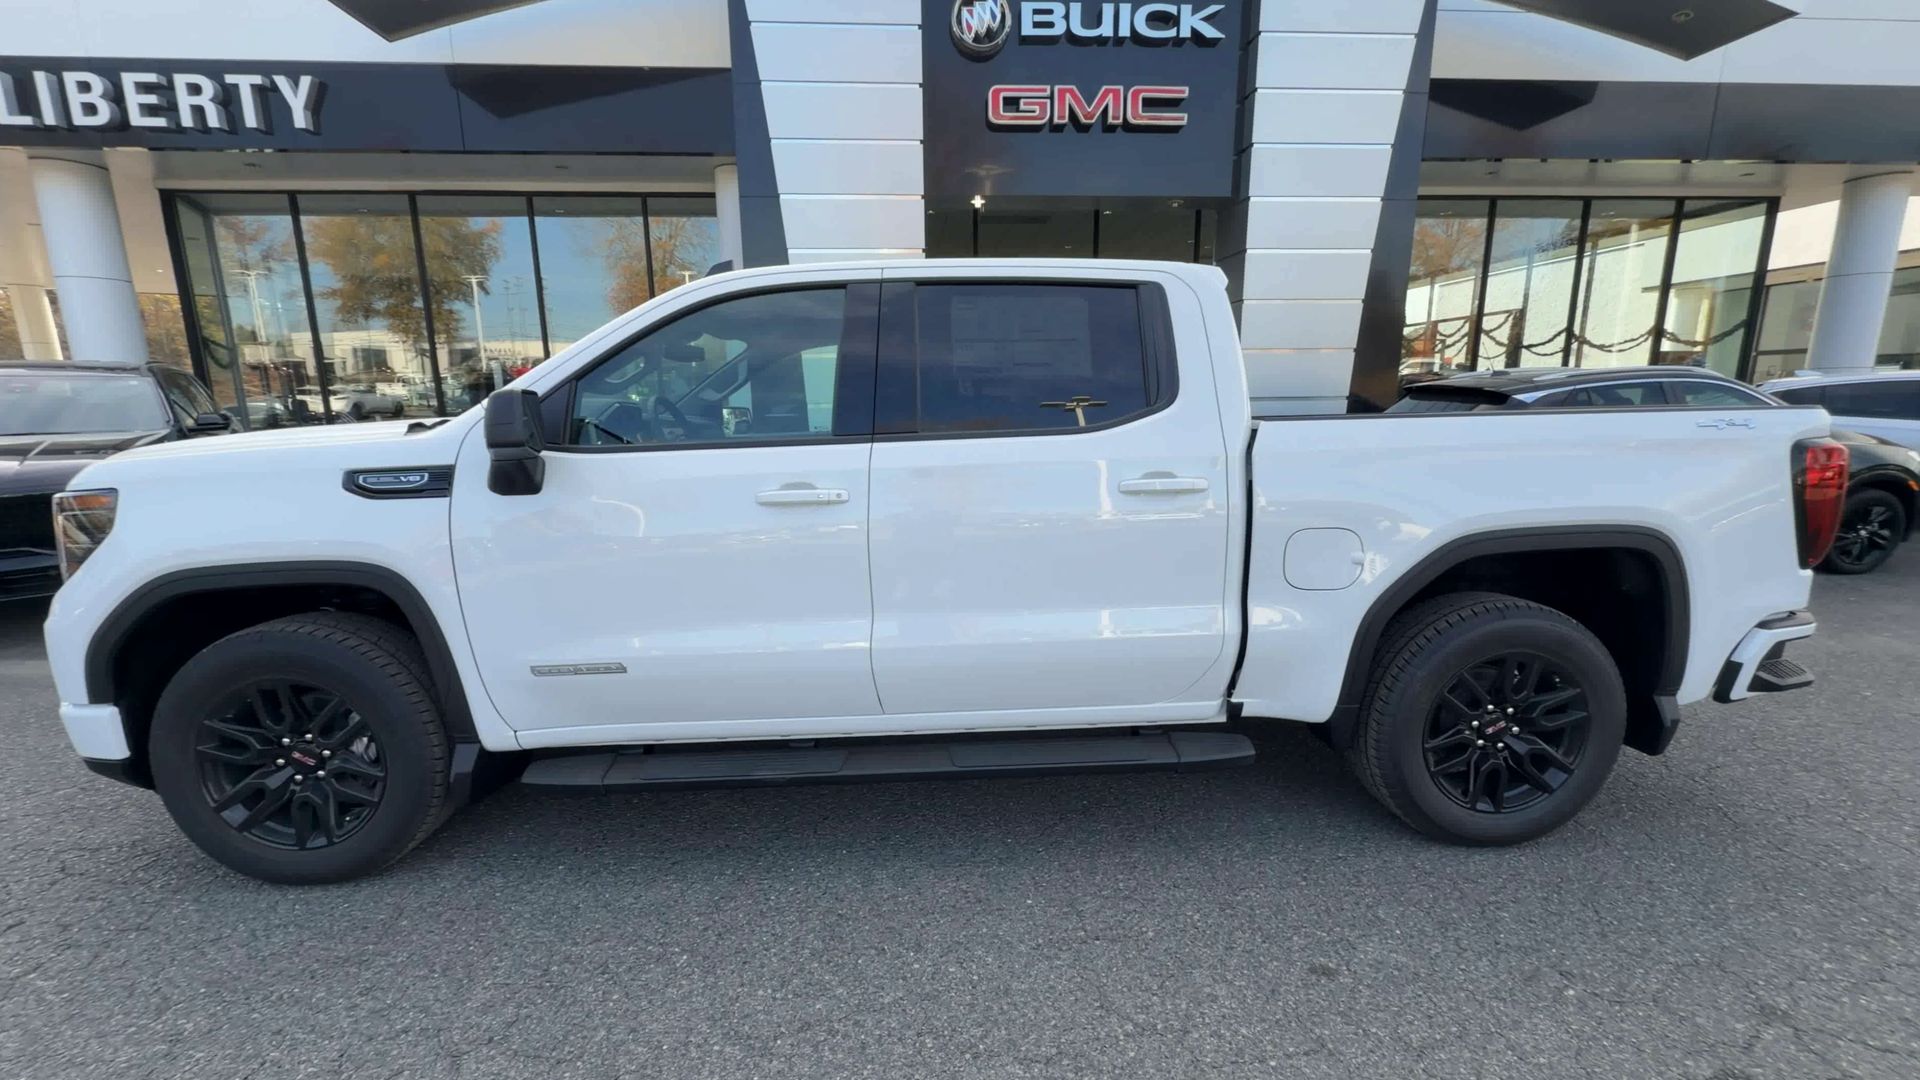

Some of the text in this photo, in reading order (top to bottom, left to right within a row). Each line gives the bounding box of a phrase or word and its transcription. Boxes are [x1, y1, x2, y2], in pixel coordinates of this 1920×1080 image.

[1020, 1, 1226, 39] BUICK
[0, 70, 315, 129] LIBERTY
[987, 84, 1190, 126] GMC
